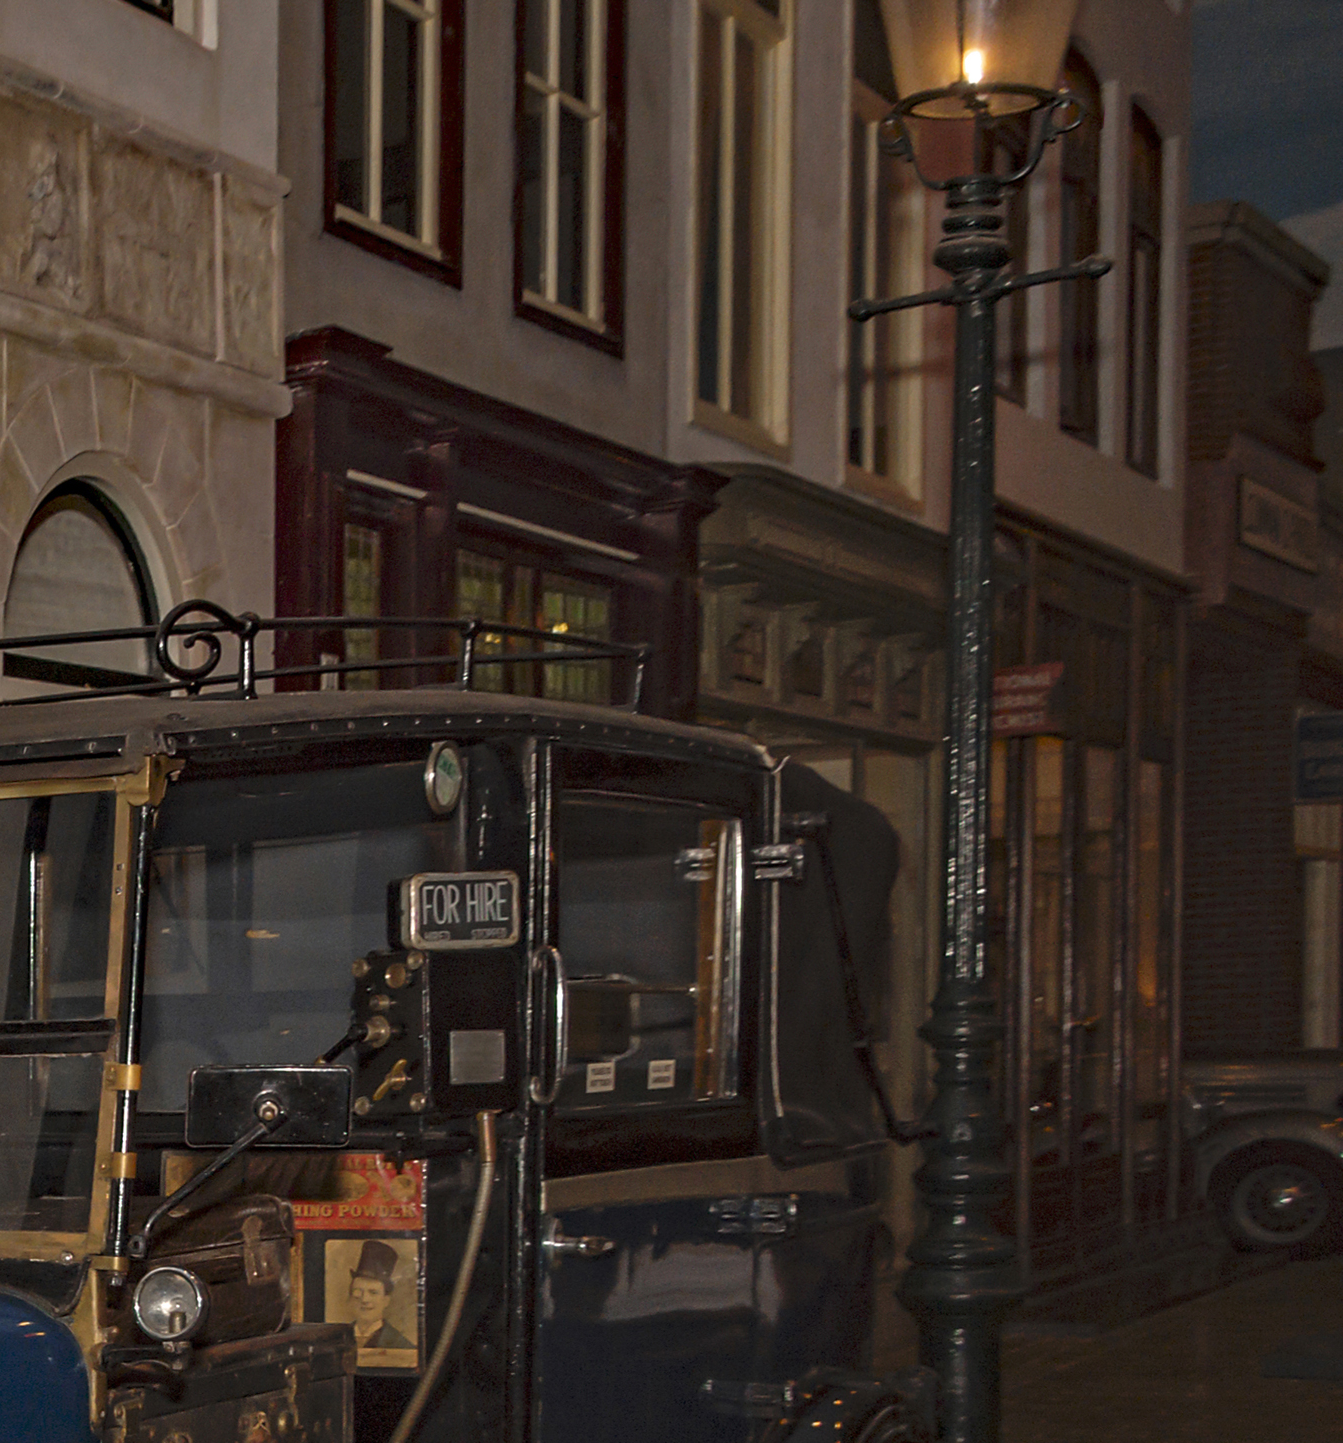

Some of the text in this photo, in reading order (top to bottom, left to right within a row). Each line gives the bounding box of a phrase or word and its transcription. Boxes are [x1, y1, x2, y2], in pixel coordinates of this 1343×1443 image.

[422, 880, 509, 925] FOR HIRE
[338, 1203, 416, 1218] POWDER
